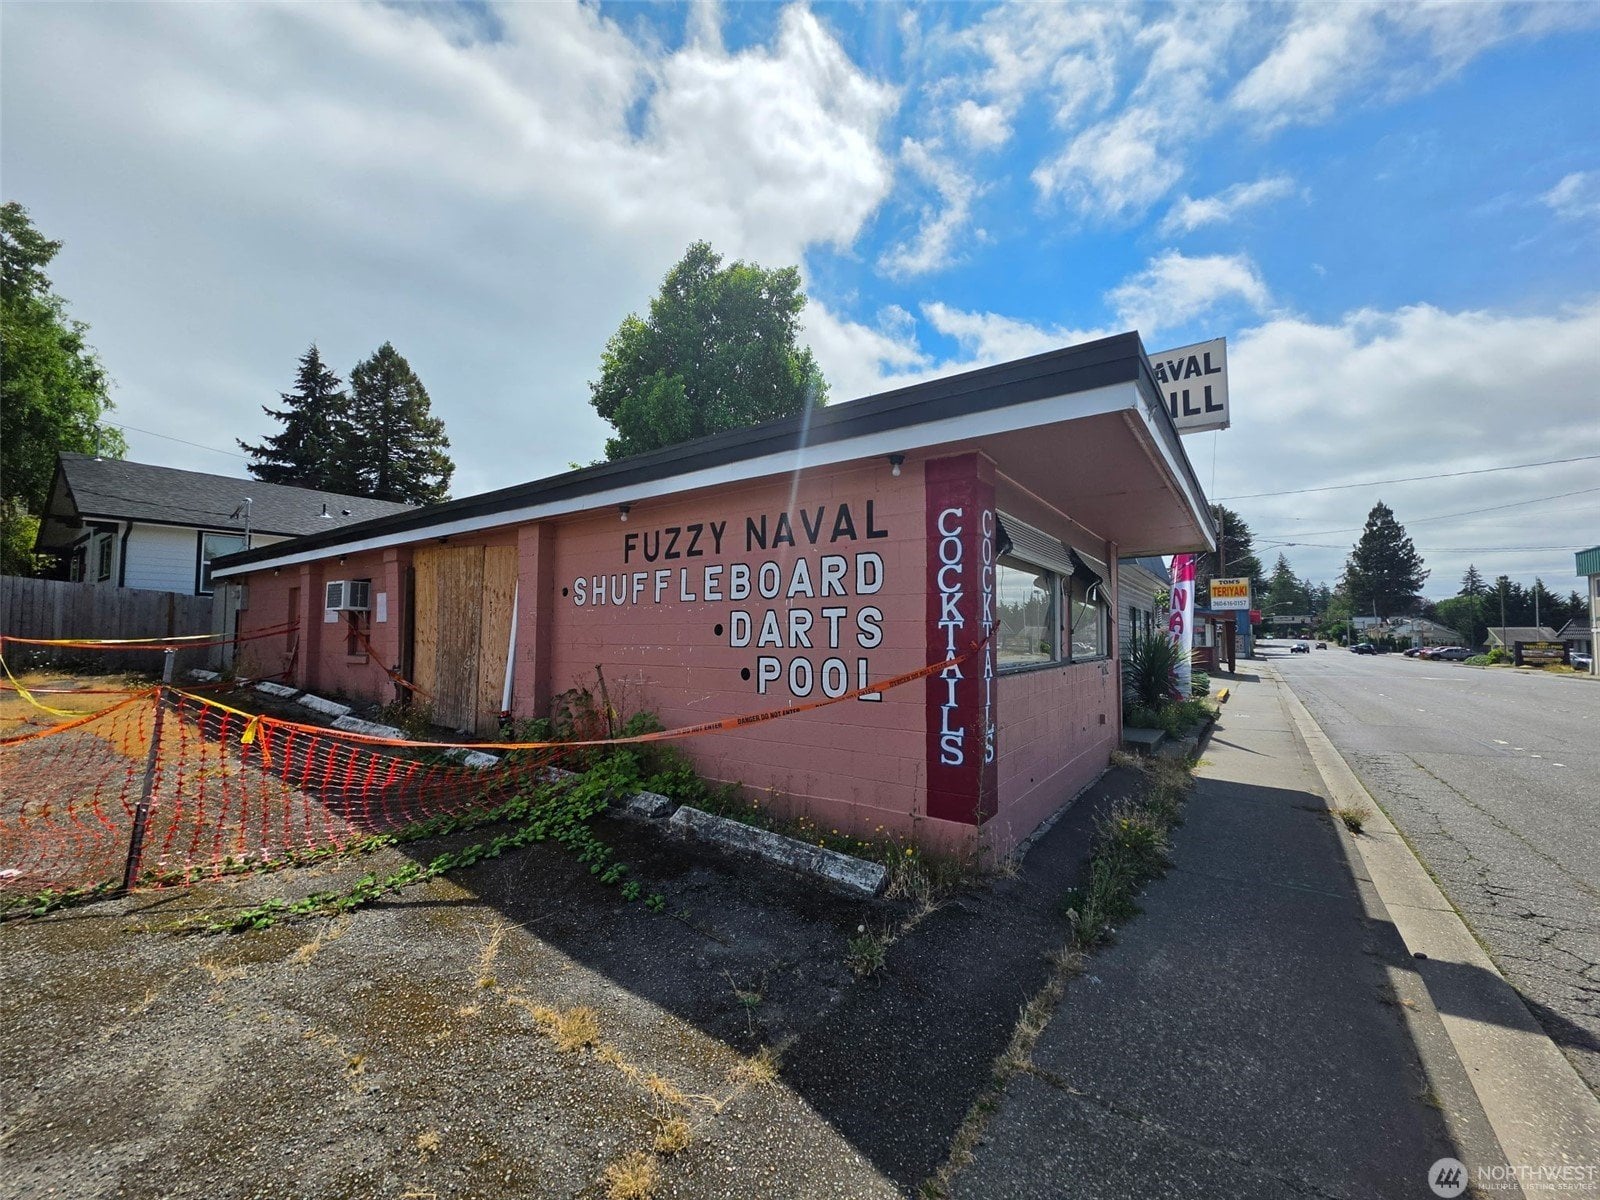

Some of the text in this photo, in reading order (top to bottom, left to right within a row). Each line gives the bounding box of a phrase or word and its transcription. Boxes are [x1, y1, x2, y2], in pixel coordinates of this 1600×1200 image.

[624, 500, 889, 563] FUZZY NAVAL
[573, 552, 885, 607] SHUFFLEBOARD
[1212, 585, 1248, 598] TERIYAKI
[729, 606, 884, 649] DARTS
[937, 507, 965, 766] COCKTAILS
[982, 509, 995, 764] COCKTAILS
[757, 655, 883, 703] POOL
[737, 714, 761, 725] DANGER
[770, 711, 781, 719] NOT
